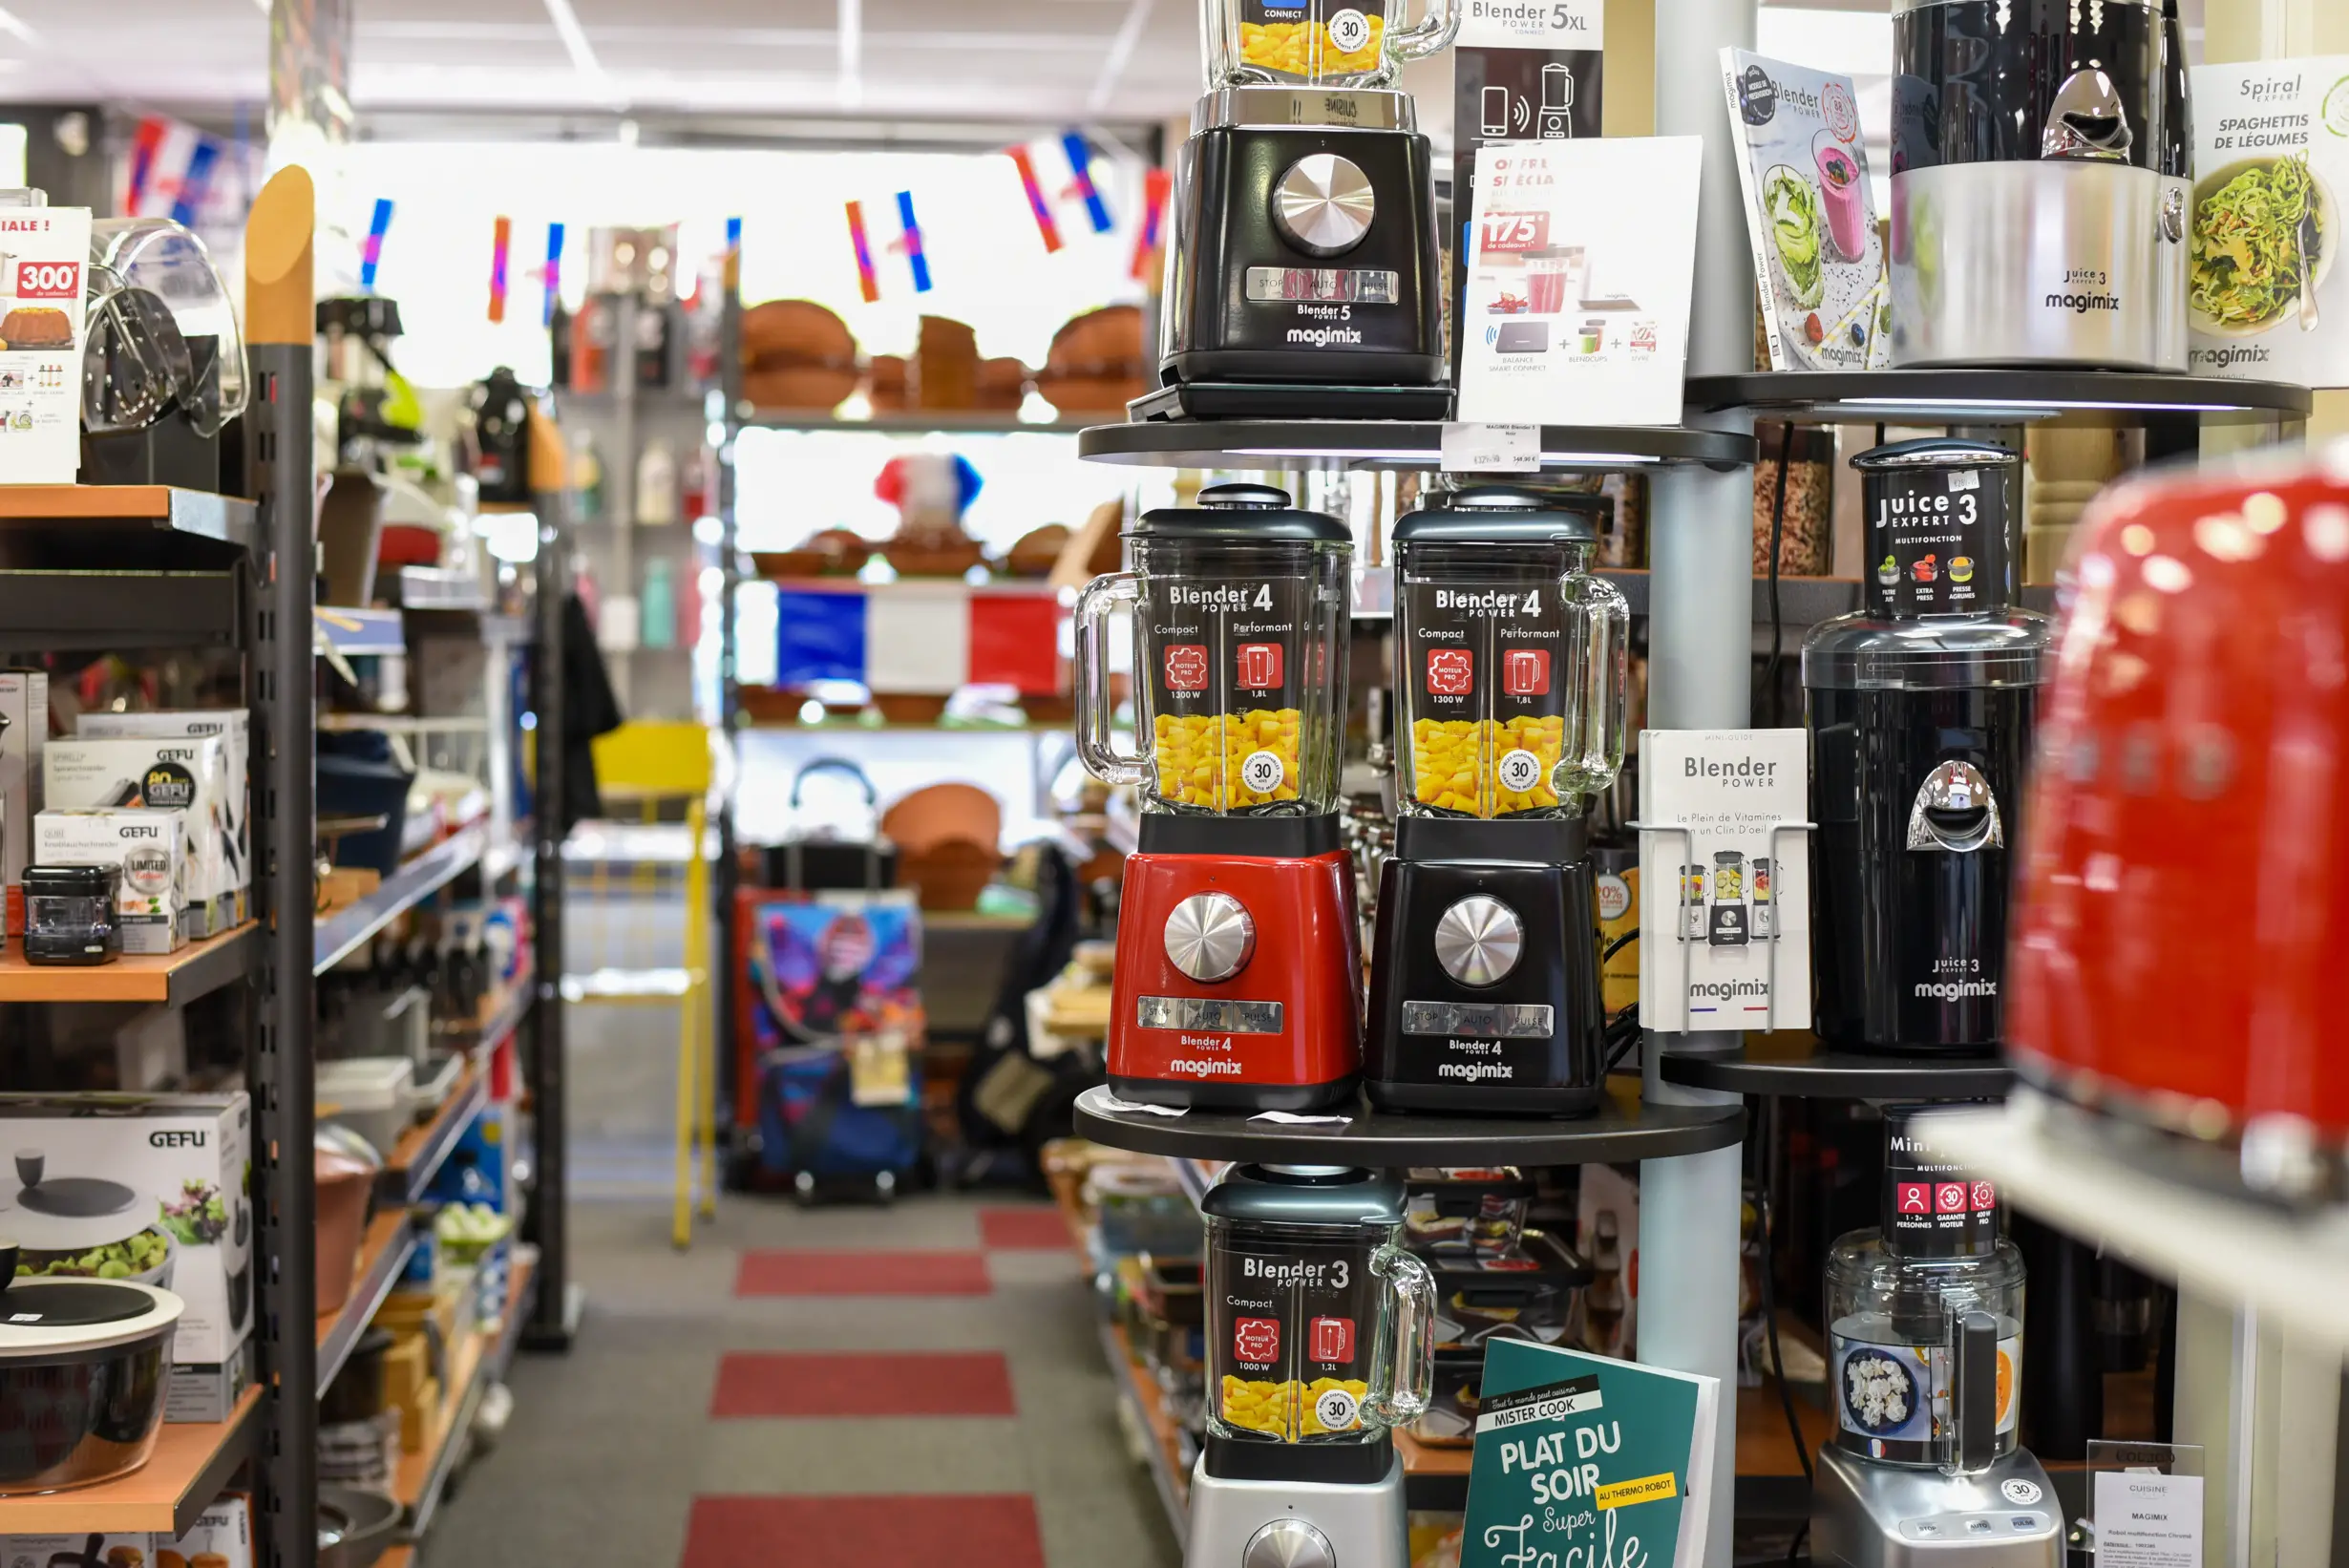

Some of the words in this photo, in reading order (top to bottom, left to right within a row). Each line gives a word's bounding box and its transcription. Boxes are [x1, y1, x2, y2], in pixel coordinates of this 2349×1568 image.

[1264, 10, 1301, 18] CONNECT
[1472, 2, 1546, 19] Blender
[1342, 22, 1358, 37] 30
[1725, 72, 1736, 109] magimix
[1771, 80, 1819, 108] Blender
[2240, 74, 2301, 99] Spiral
[2257, 93, 2299, 102] EXPERT
[1793, 105, 1820, 118] POWER
[2219, 114, 2309, 131] SPAGHETTIS
[2214, 137, 2233, 149] DE
[2238, 132, 2308, 148] LÉGUMES
[1757, 252, 1766, 279] Power
[2063, 267, 2096, 283] Juice
[2099, 272, 2106, 285] 3
[1259, 279, 1283, 287] STOP
[1310, 281, 1337, 289] AUTO
[1362, 282, 1388, 290] PULSE
[1761, 281, 1771, 311] Blender
[2045, 291, 2119, 313] magimix
[1298, 305, 1339, 315] Blender
[1341, 306, 1351, 321] 5
[1286, 326, 1362, 347] magimix
[1821, 346, 1862, 367] magimix
[2189, 344, 2270, 369] magimix
[1876, 490, 1949, 528] Juice
[1958, 494, 1977, 525] 3
[1893, 516, 1950, 527] EXPERT
[1894, 535, 1962, 544] MULTIFONCTION
[1170, 584, 1249, 604] Blender
[1253, 583, 1273, 611] 4
[1436, 590, 1517, 608] Blender
[1521, 590, 1542, 618] 4
[1469, 609, 1515, 618] POWER
[1154, 625, 1198, 636] Compact
[1234, 621, 1293, 633] Performant
[1418, 627, 1465, 641] Compact
[1500, 627, 1559, 638] Performant
[1251, 689, 1266, 698] 1,8L
[1516, 695, 1532, 704] 1,8L
[187, 723, 222, 734] GEFU
[157, 749, 194, 761] GEFU
[1255, 763, 1271, 778] 30
[1512, 762, 1529, 777] 30
[1684, 756, 1777, 776] Blender
[1245, 775, 1264, 791] GARANTIE
[1266, 774, 1280, 790] MOTEUR
[1502, 773, 1521, 790] GARANTIE
[1522, 773, 1537, 789] MOTEUR
[1723, 778, 1774, 787] POWER
[1677, 814, 1687, 823] Le
[1691, 814, 1714, 822] Plein
[1719, 813, 1730, 822] de
[1734, 812, 1782, 821] Vitamines
[119, 827, 158, 838] GEFU
[1715, 825, 1734, 835] Clin
[132, 860, 166, 871] LIMITED
[1932, 956, 1967, 973] Juice
[1971, 959, 1979, 972] 3
[1690, 978, 1768, 1001] magimix
[1915, 978, 1997, 1003] magimix
[1196, 1012, 1222, 1021] AUTO
[1244, 1012, 1272, 1022] PULSE
[1414, 1012, 1438, 1021] STOP
[1463, 1016, 1492, 1025] AUTO
[1515, 1017, 1543, 1026] PULSE
[1181, 1035, 1220, 1047] Blender
[1221, 1037, 1232, 1051] 4
[1450, 1040, 1491, 1050] Blender
[1492, 1041, 1502, 1055] 4
[1171, 1057, 1241, 1078] magimix
[1439, 1061, 1513, 1082] magimix
[149, 1131, 205, 1148] GEFU
[1945, 1191, 1958, 1202] 30
[1244, 1258, 1325, 1278] Blender
[1331, 1260, 1349, 1289] 3
[1278, 1278, 1323, 1287] POWER
[1227, 1296, 1272, 1309] Compact
[1239, 1362, 1259, 1370] 1000
[1322, 1363, 1337, 1371] 1,2L
[1492, 1399, 1507, 1409] Tout
[1507, 1397, 1513, 1406] le
[1514, 1392, 1536, 1404] monde
[1537, 1390, 1551, 1404] peut
[1552, 1386, 1577, 1397] cuisiner
[1328, 1402, 1345, 1416] 30
[1494, 1407, 1536, 1427] MISTER
[1539, 1398, 1576, 1417] COOK
[1320, 1412, 1338, 1428] GARANTIE
[1340, 1412, 1354, 1428] MOTEUR
[1500, 1431, 1566, 1474] PLAT
[1576, 1420, 1621, 1459] DU
[1531, 1463, 1600, 1505] SOIR
[1599, 1492, 1611, 1501] AU
[1612, 1486, 1643, 1499] THERMO
[1645, 1480, 1671, 1492] ROBOT
[2012, 1484, 2030, 1494] 30
[2129, 1485, 2168, 1494] CUISINE
[1543, 1507, 1596, 1540] Super
[2131, 1513, 2169, 1521] MAGIMIX
[1484, 1507, 1648, 1568] Facile
